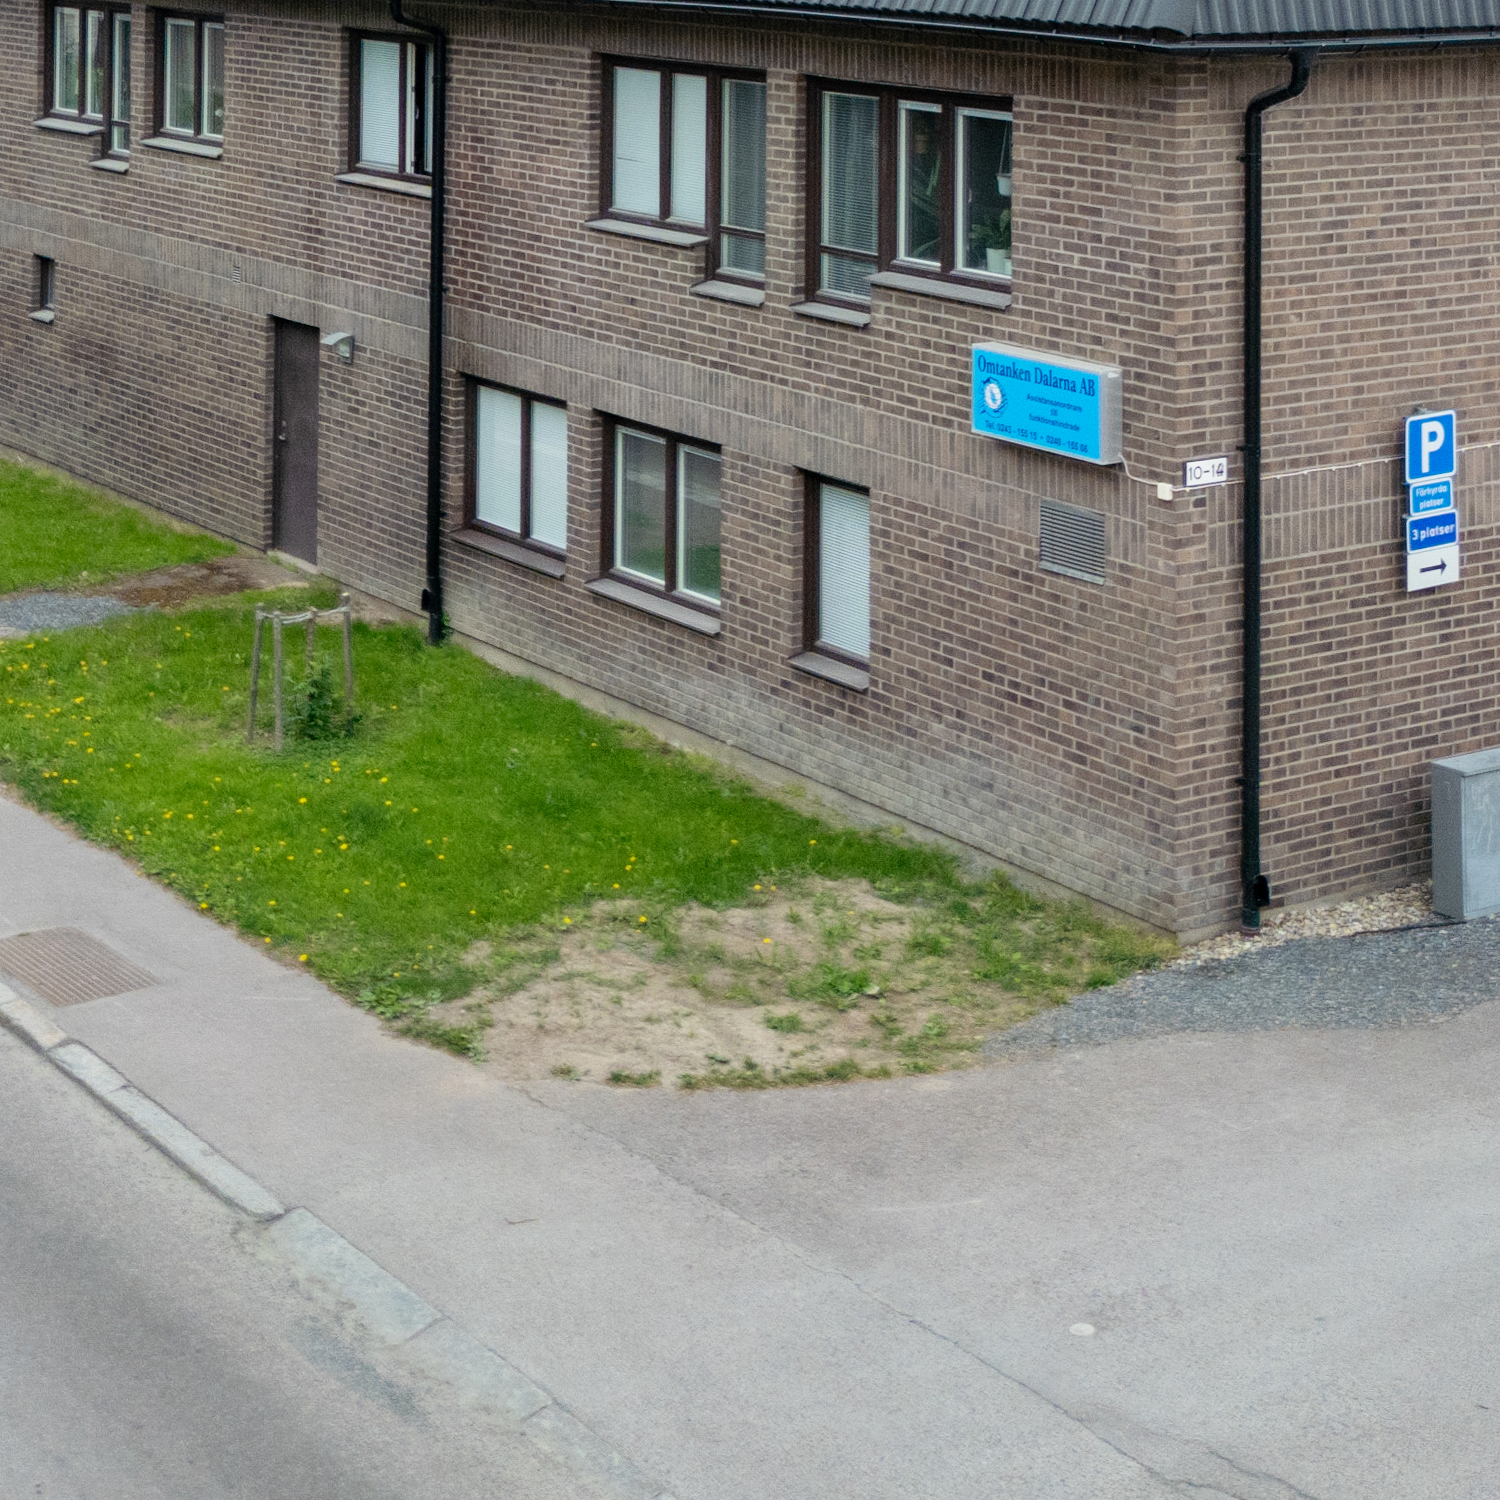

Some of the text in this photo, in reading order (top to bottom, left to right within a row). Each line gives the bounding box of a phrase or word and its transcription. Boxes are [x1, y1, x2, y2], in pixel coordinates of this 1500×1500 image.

[978, 354, 1095, 397] Omtanken Dalarna AB
[1421, 420, 1445, 473] P
[1415, 485, 1448, 497] Förhyrda
[1419, 498, 1444, 510] platser
[1412, 523, 1455, 542] 3 platser
